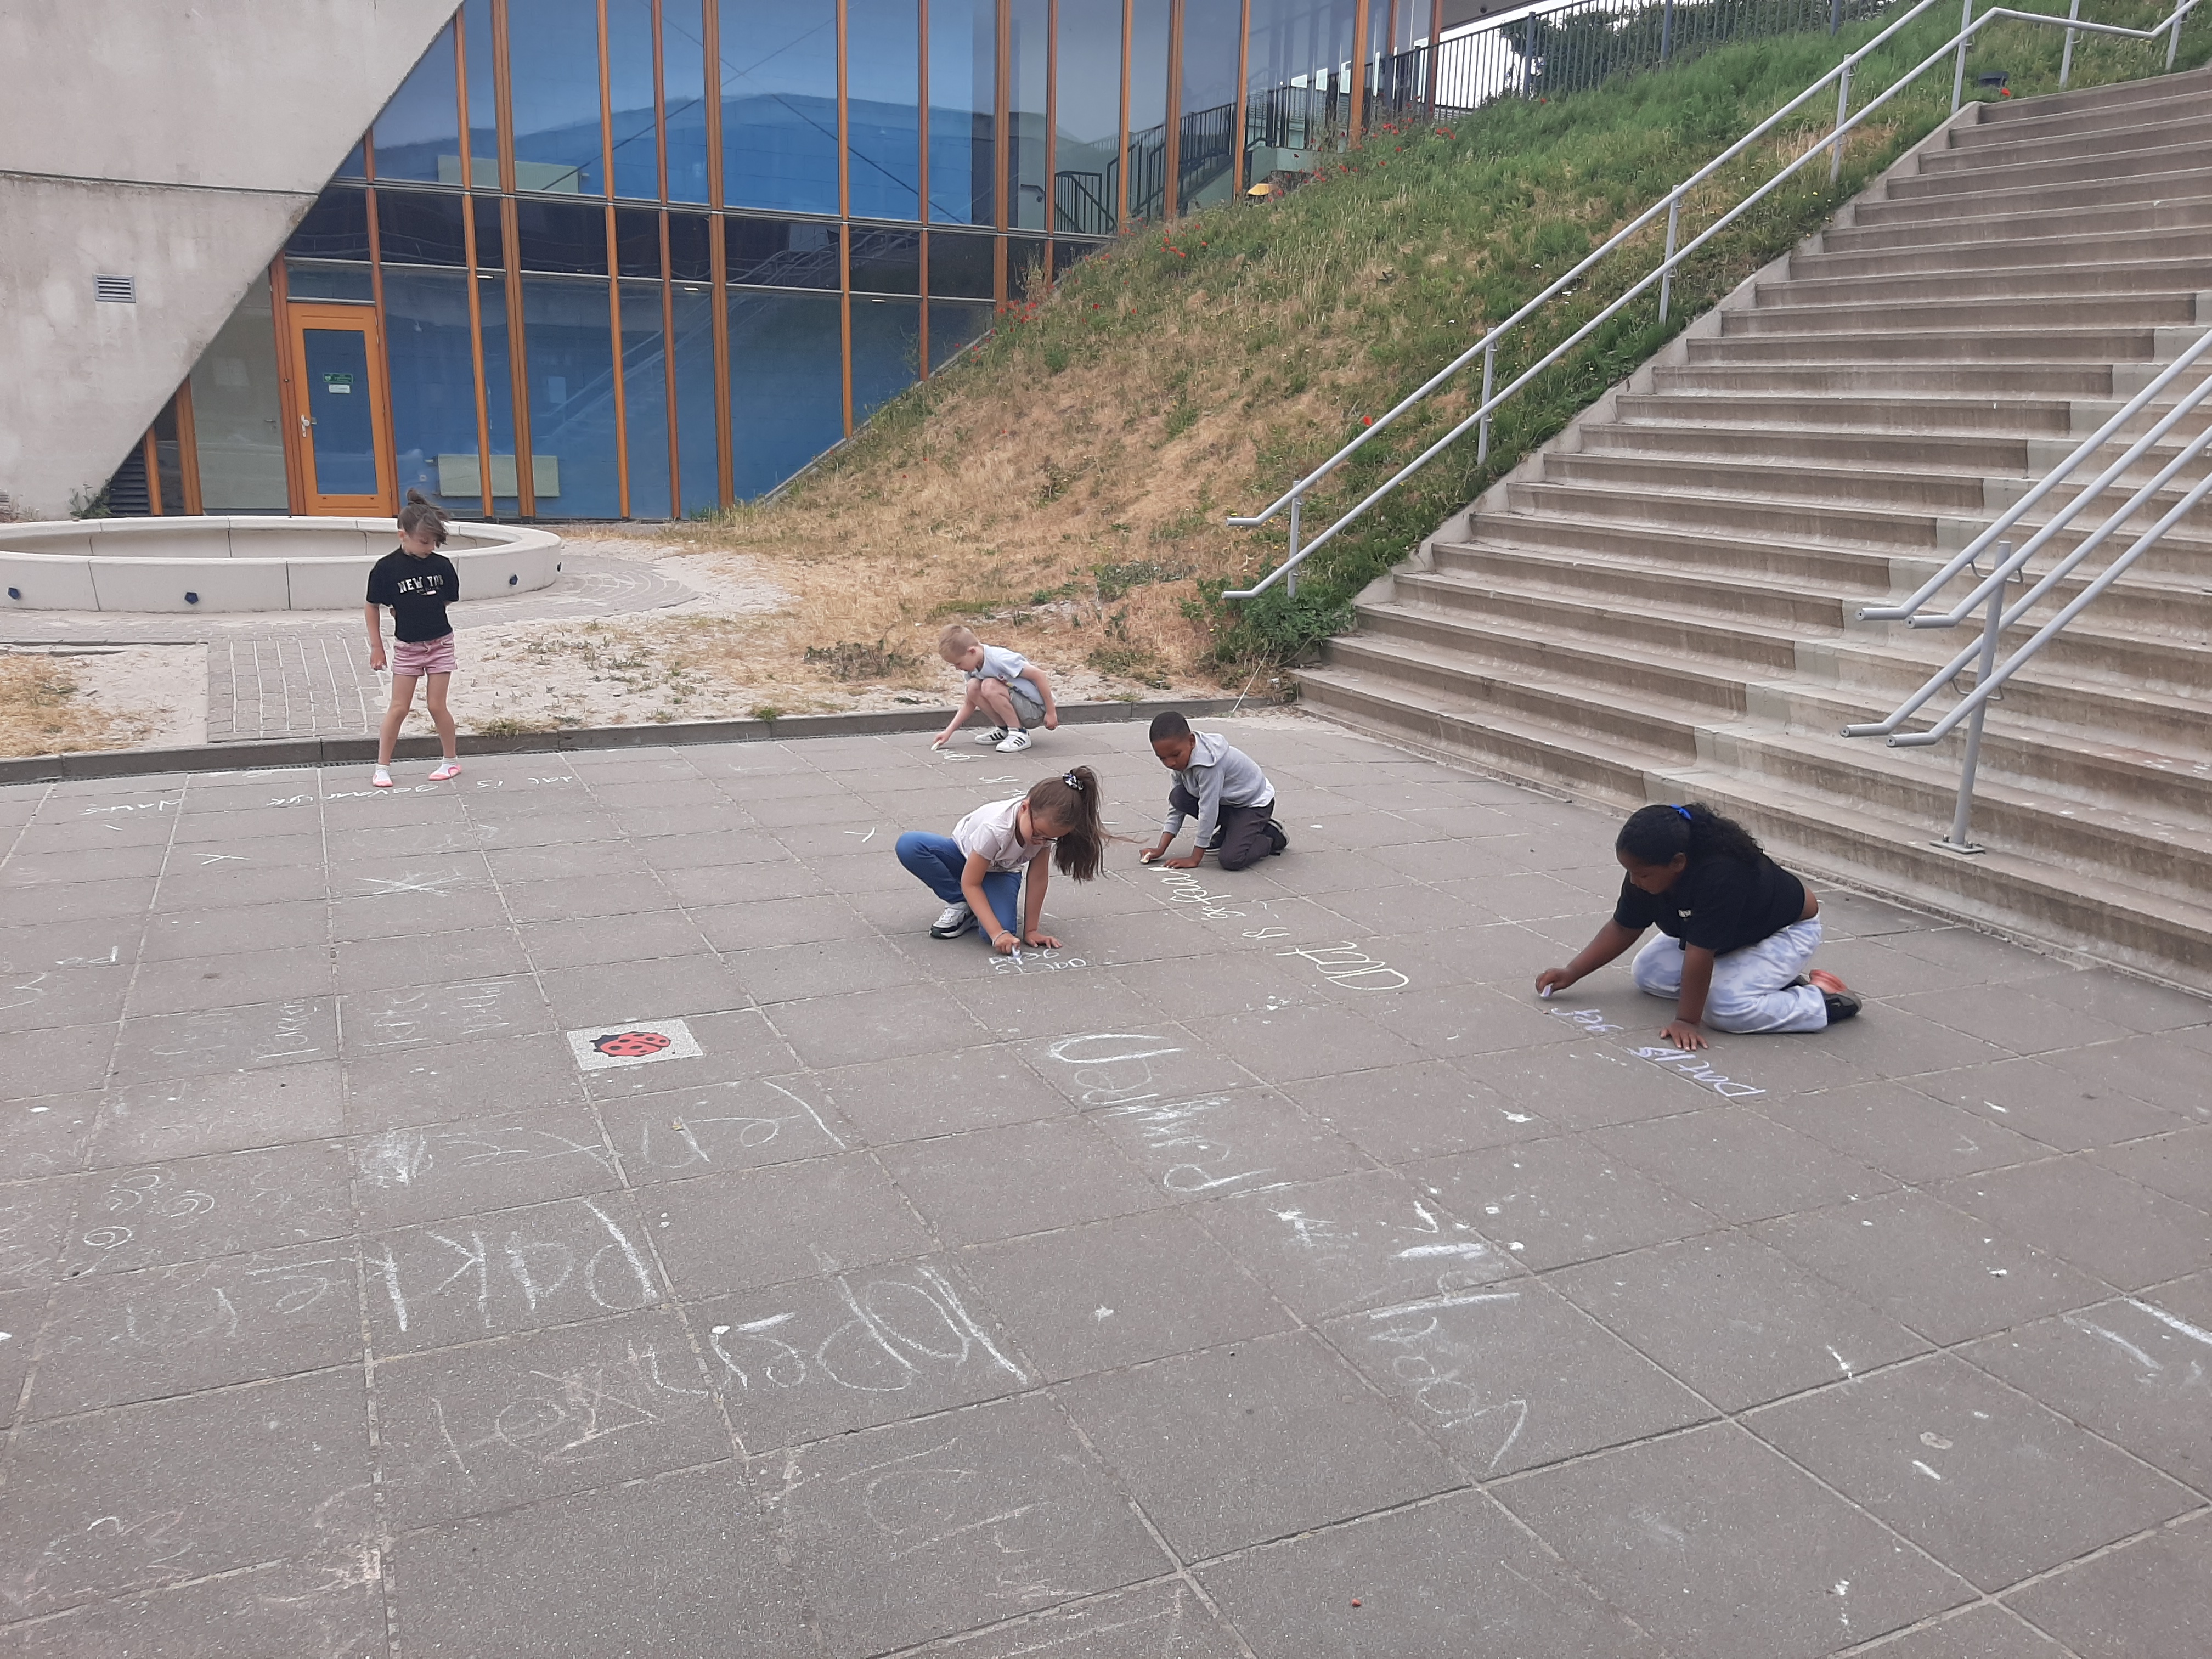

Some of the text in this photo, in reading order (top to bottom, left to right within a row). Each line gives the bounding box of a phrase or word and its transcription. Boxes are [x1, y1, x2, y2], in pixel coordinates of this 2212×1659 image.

[397, 576, 423, 594] NEW
[476, 779, 504, 789] is
[1677, 1060, 1767, 1097] Dat
